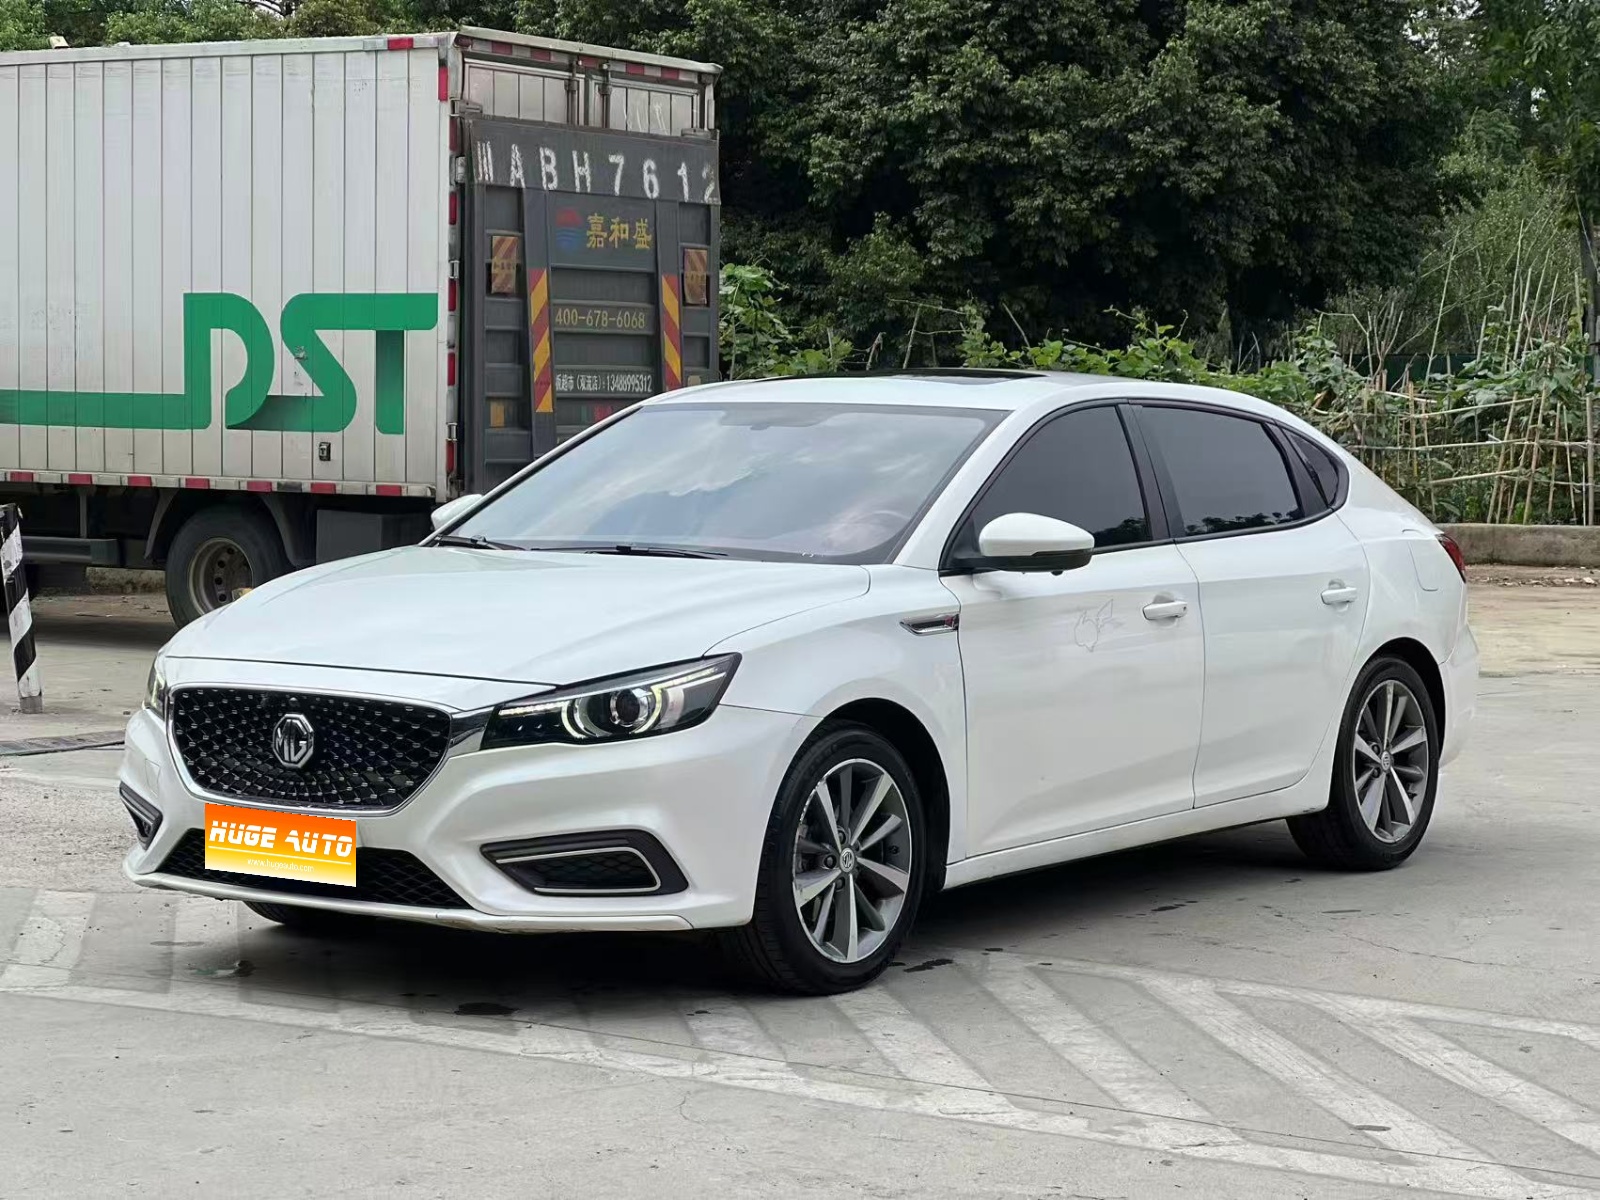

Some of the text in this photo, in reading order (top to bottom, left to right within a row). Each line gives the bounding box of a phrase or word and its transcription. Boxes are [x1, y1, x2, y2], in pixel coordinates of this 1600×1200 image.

[586, 212, 651, 249] 嘉和盛
[555, 307, 646, 330] 400-678-6068
[183, 292, 438, 435] DST
[273, 715, 313, 766] MG
